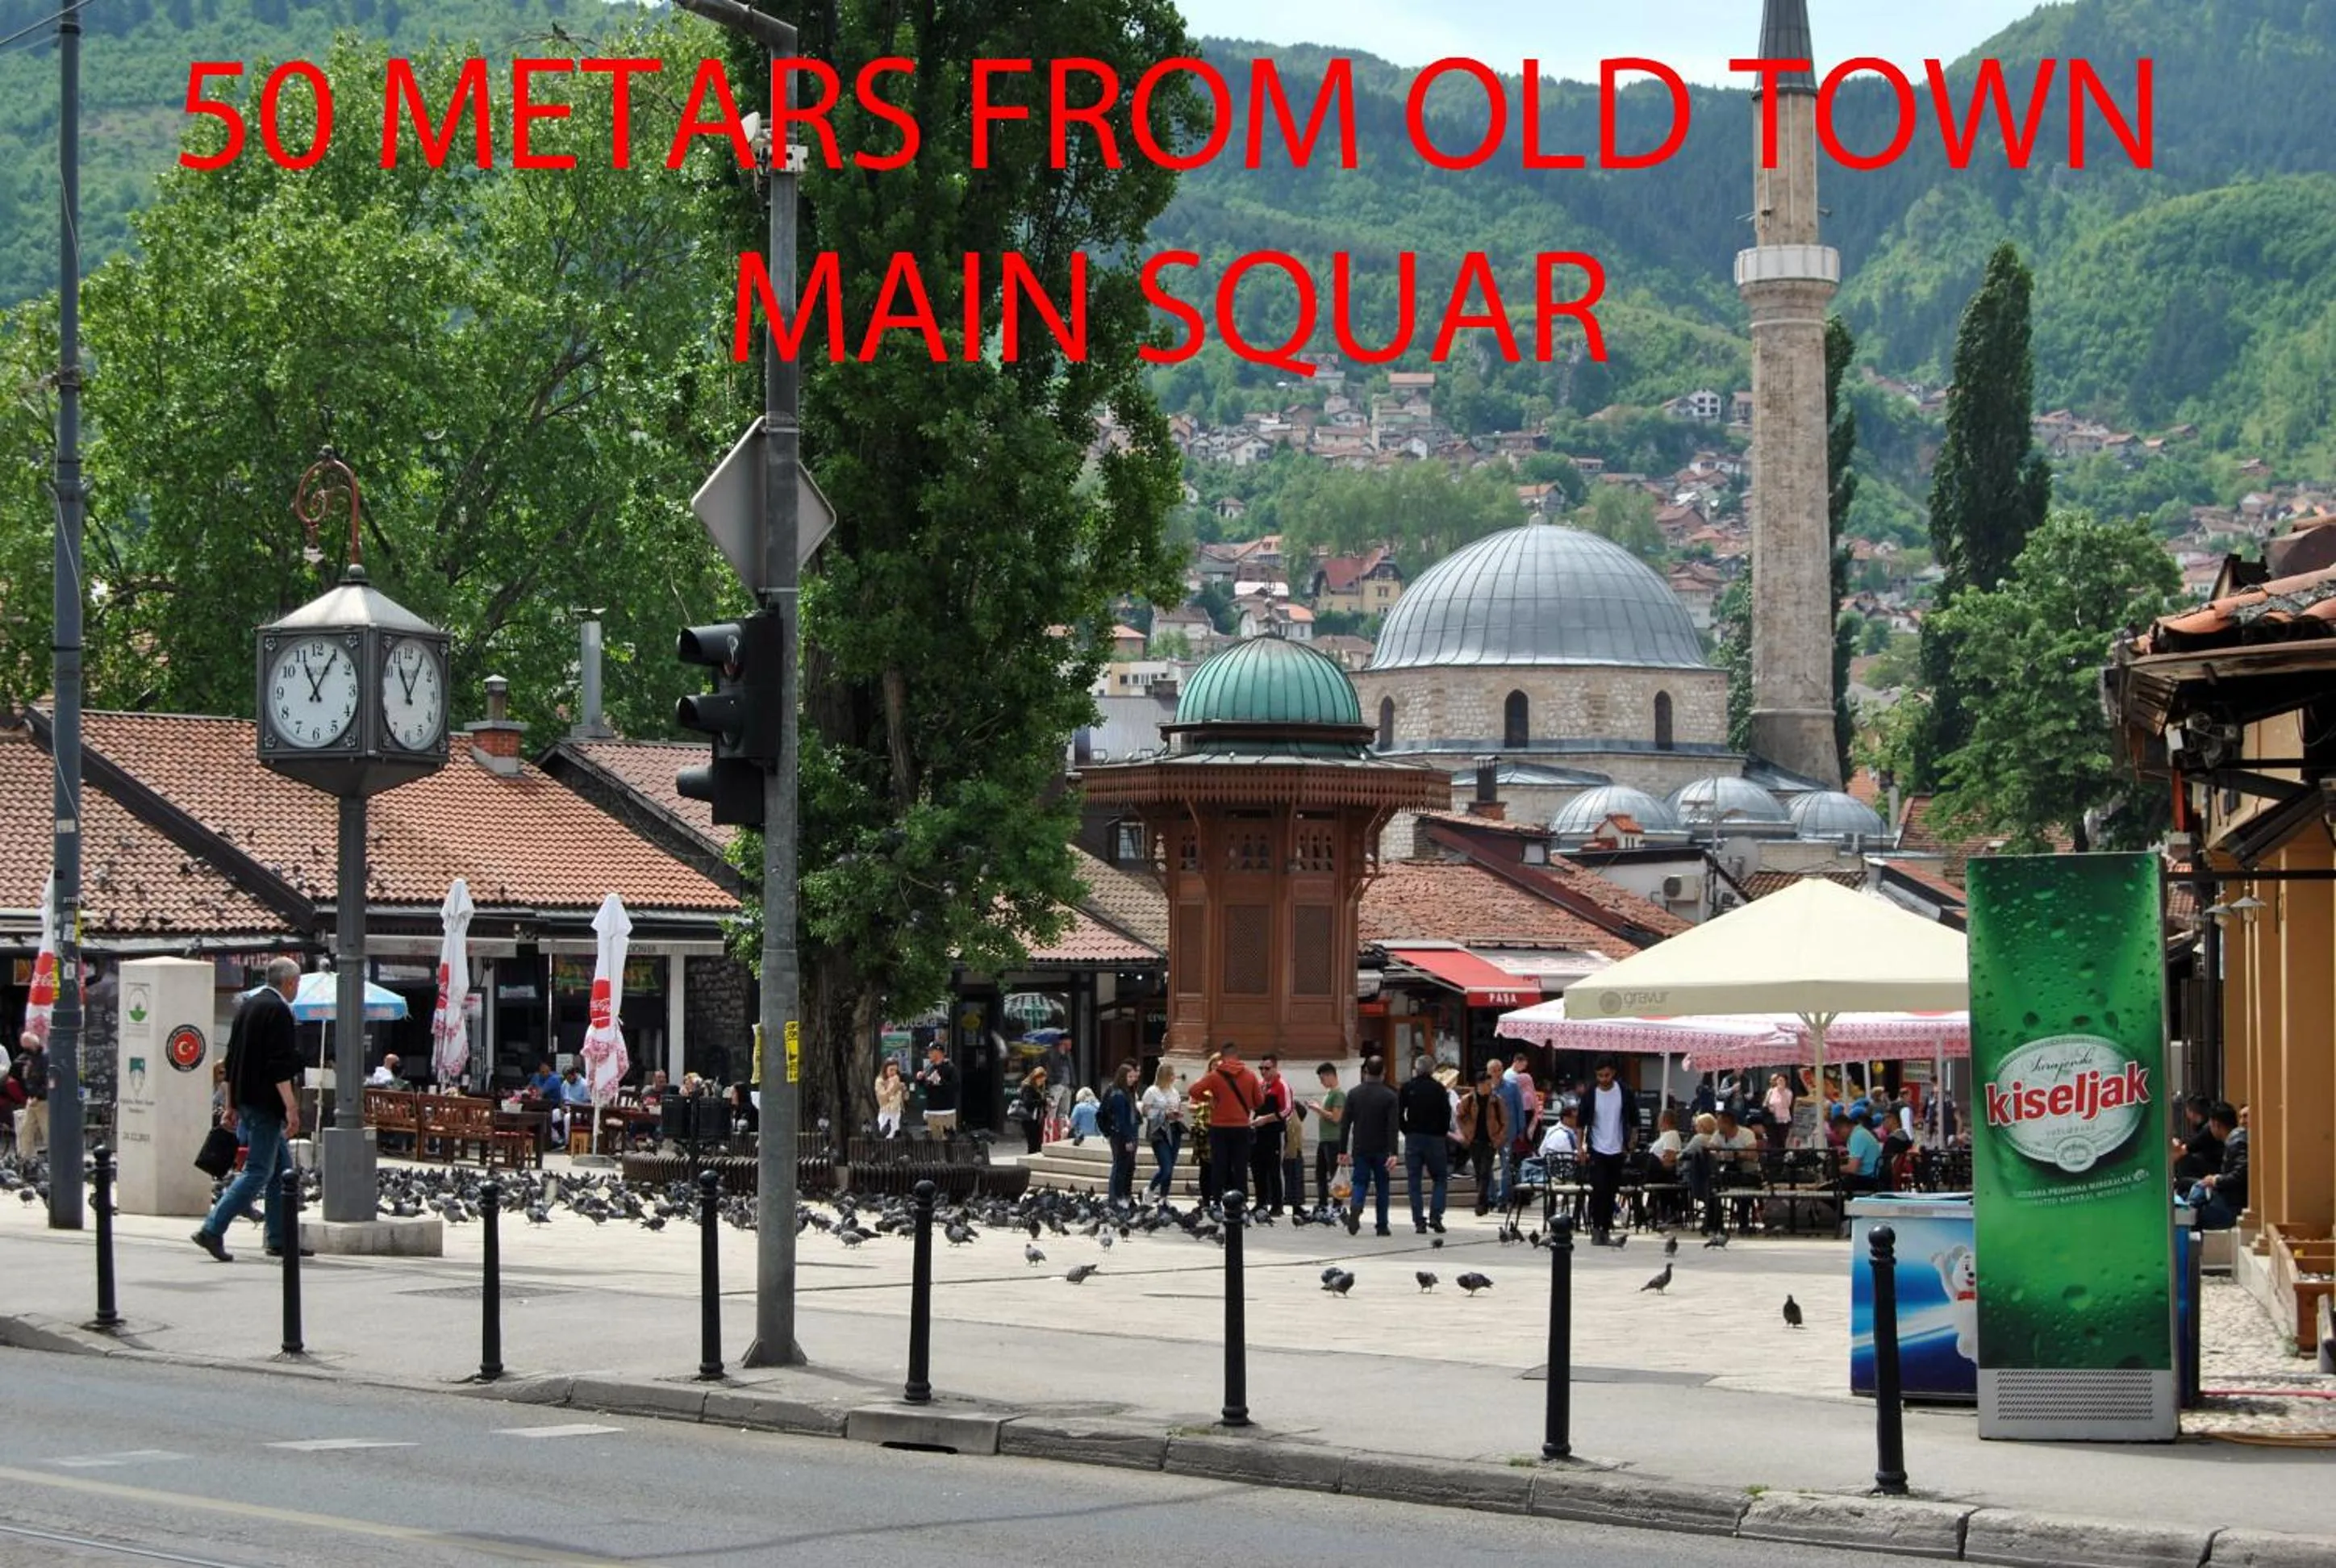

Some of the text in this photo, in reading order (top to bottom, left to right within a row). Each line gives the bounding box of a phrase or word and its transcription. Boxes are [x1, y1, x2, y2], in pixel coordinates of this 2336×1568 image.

[296, 649, 307, 662] 11
[311, 644, 323, 657] 12
[404, 647, 414, 660] 12
[282, 665, 296, 678] 10
[344, 663, 352, 676] 2
[276, 686, 285, 700] 9
[348, 684, 356, 698] 3
[281, 707, 290, 719] 8
[344, 704, 352, 717] 4
[294, 720, 303, 734] 7
[330, 719, 339, 733] 5
[312, 728, 320, 741] 6
[1985, 1061, 2150, 1126] kiseljak
